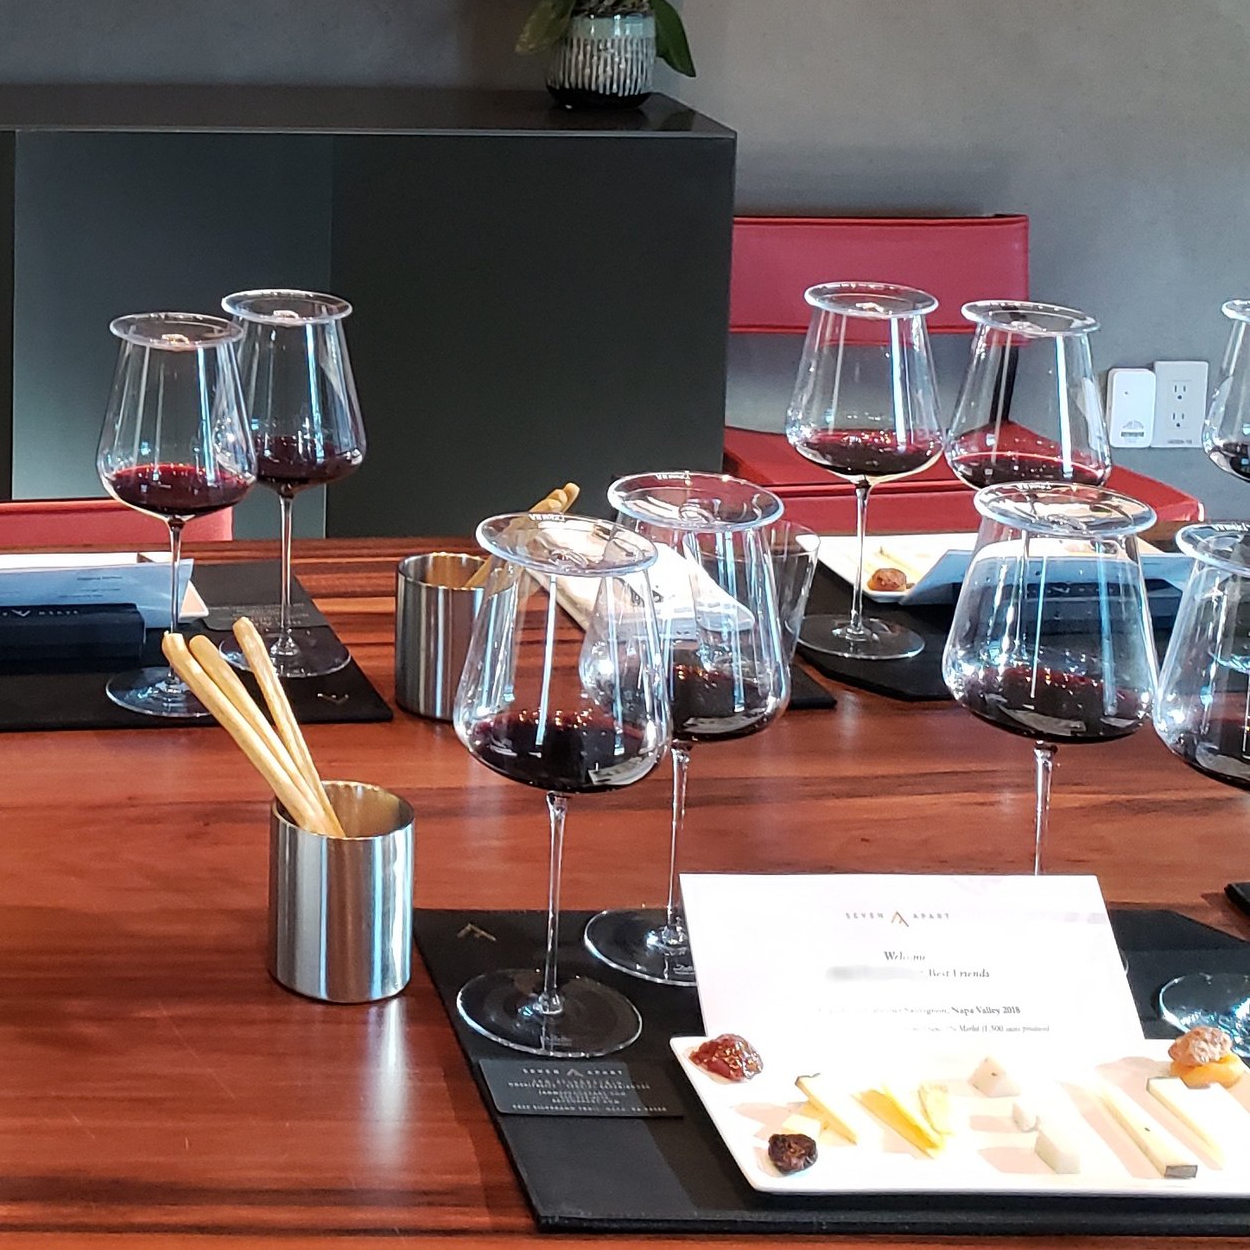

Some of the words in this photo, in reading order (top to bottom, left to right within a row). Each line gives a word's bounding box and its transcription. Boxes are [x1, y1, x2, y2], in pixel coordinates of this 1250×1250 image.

[951, 1006, 975, 1017] Napa
[976, 1005, 1001, 1016] Valley
[1002, 1005, 1022, 1015] 2018
